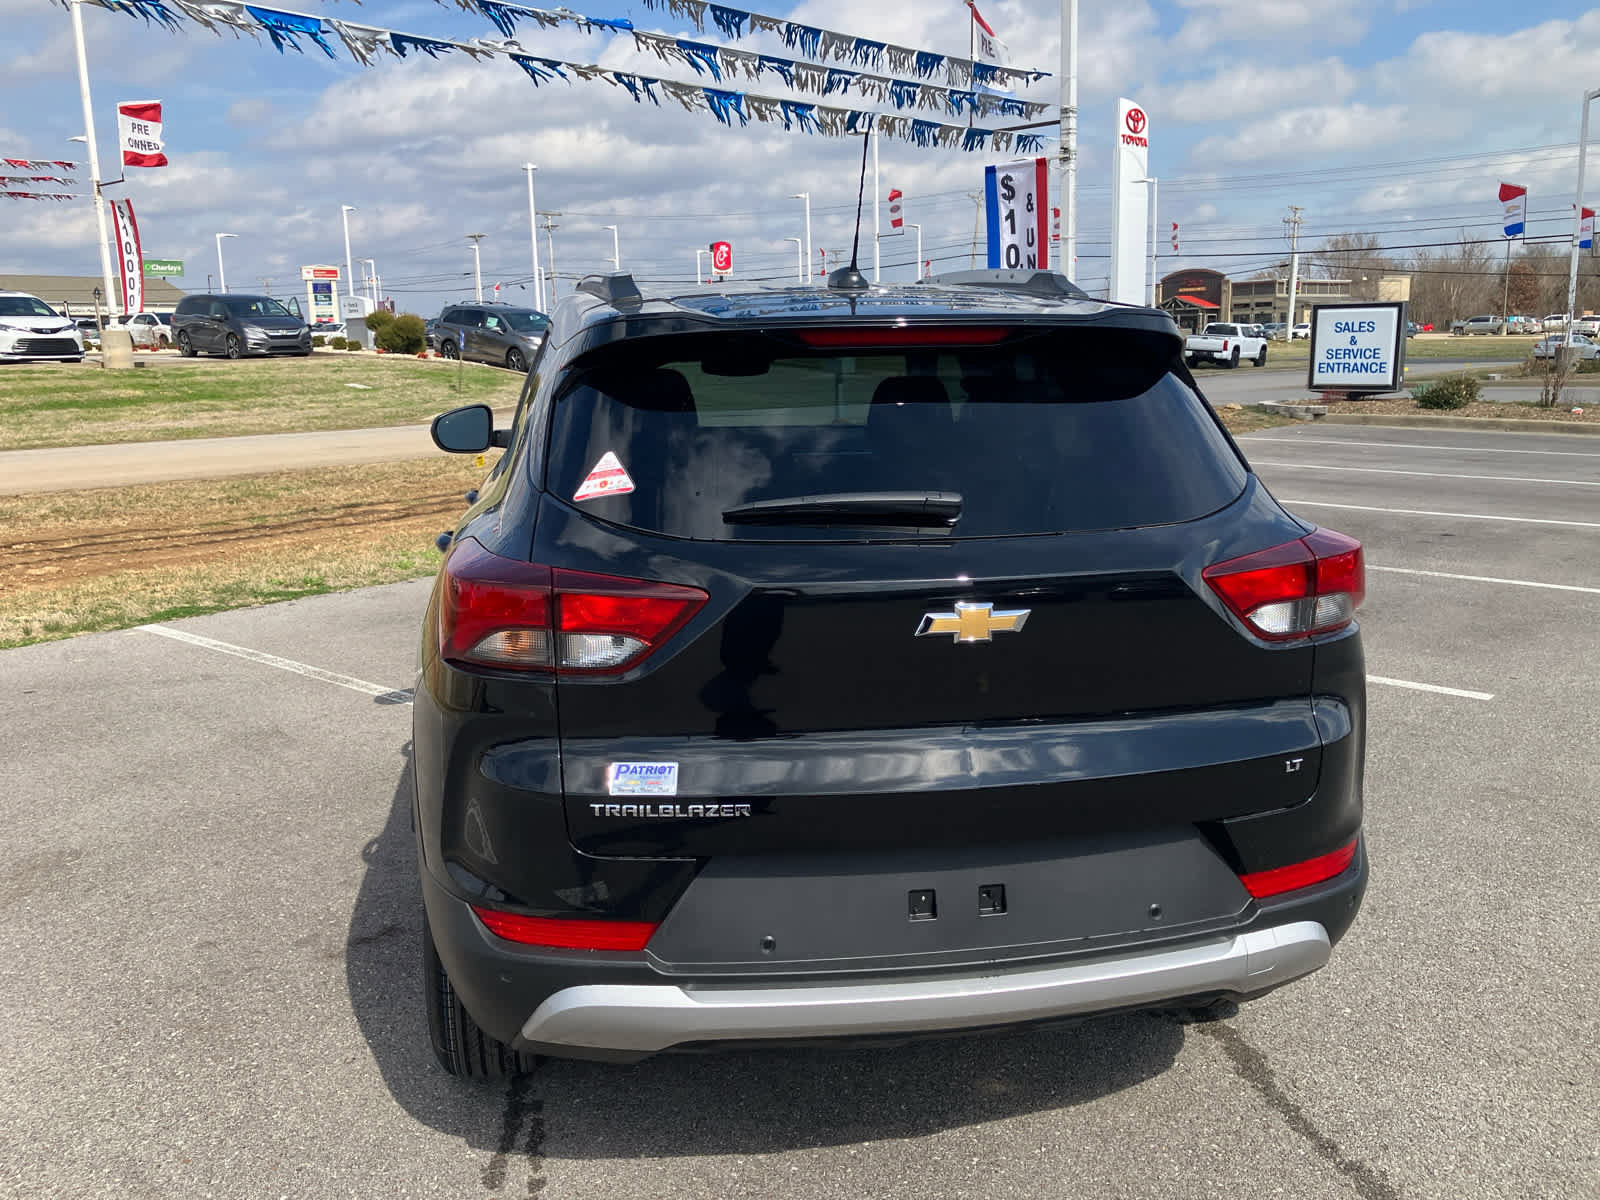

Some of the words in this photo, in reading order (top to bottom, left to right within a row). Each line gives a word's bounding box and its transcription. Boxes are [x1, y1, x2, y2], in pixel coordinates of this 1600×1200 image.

[131, 122, 150, 136] PRE
[127, 137, 160, 151] OWNED
[1121, 134, 1148, 147] TOYOTA
[1334, 321, 1375, 333] SALES
[1349, 335, 1358, 346] &
[1326, 348, 1381, 360] SERVICE
[1318, 361, 1387, 374] ENTRANCE
[614, 763, 675, 780] PATRIOT
[1285, 758, 1304, 773] LT
[589, 803, 751, 818] TRAILBLAZER
